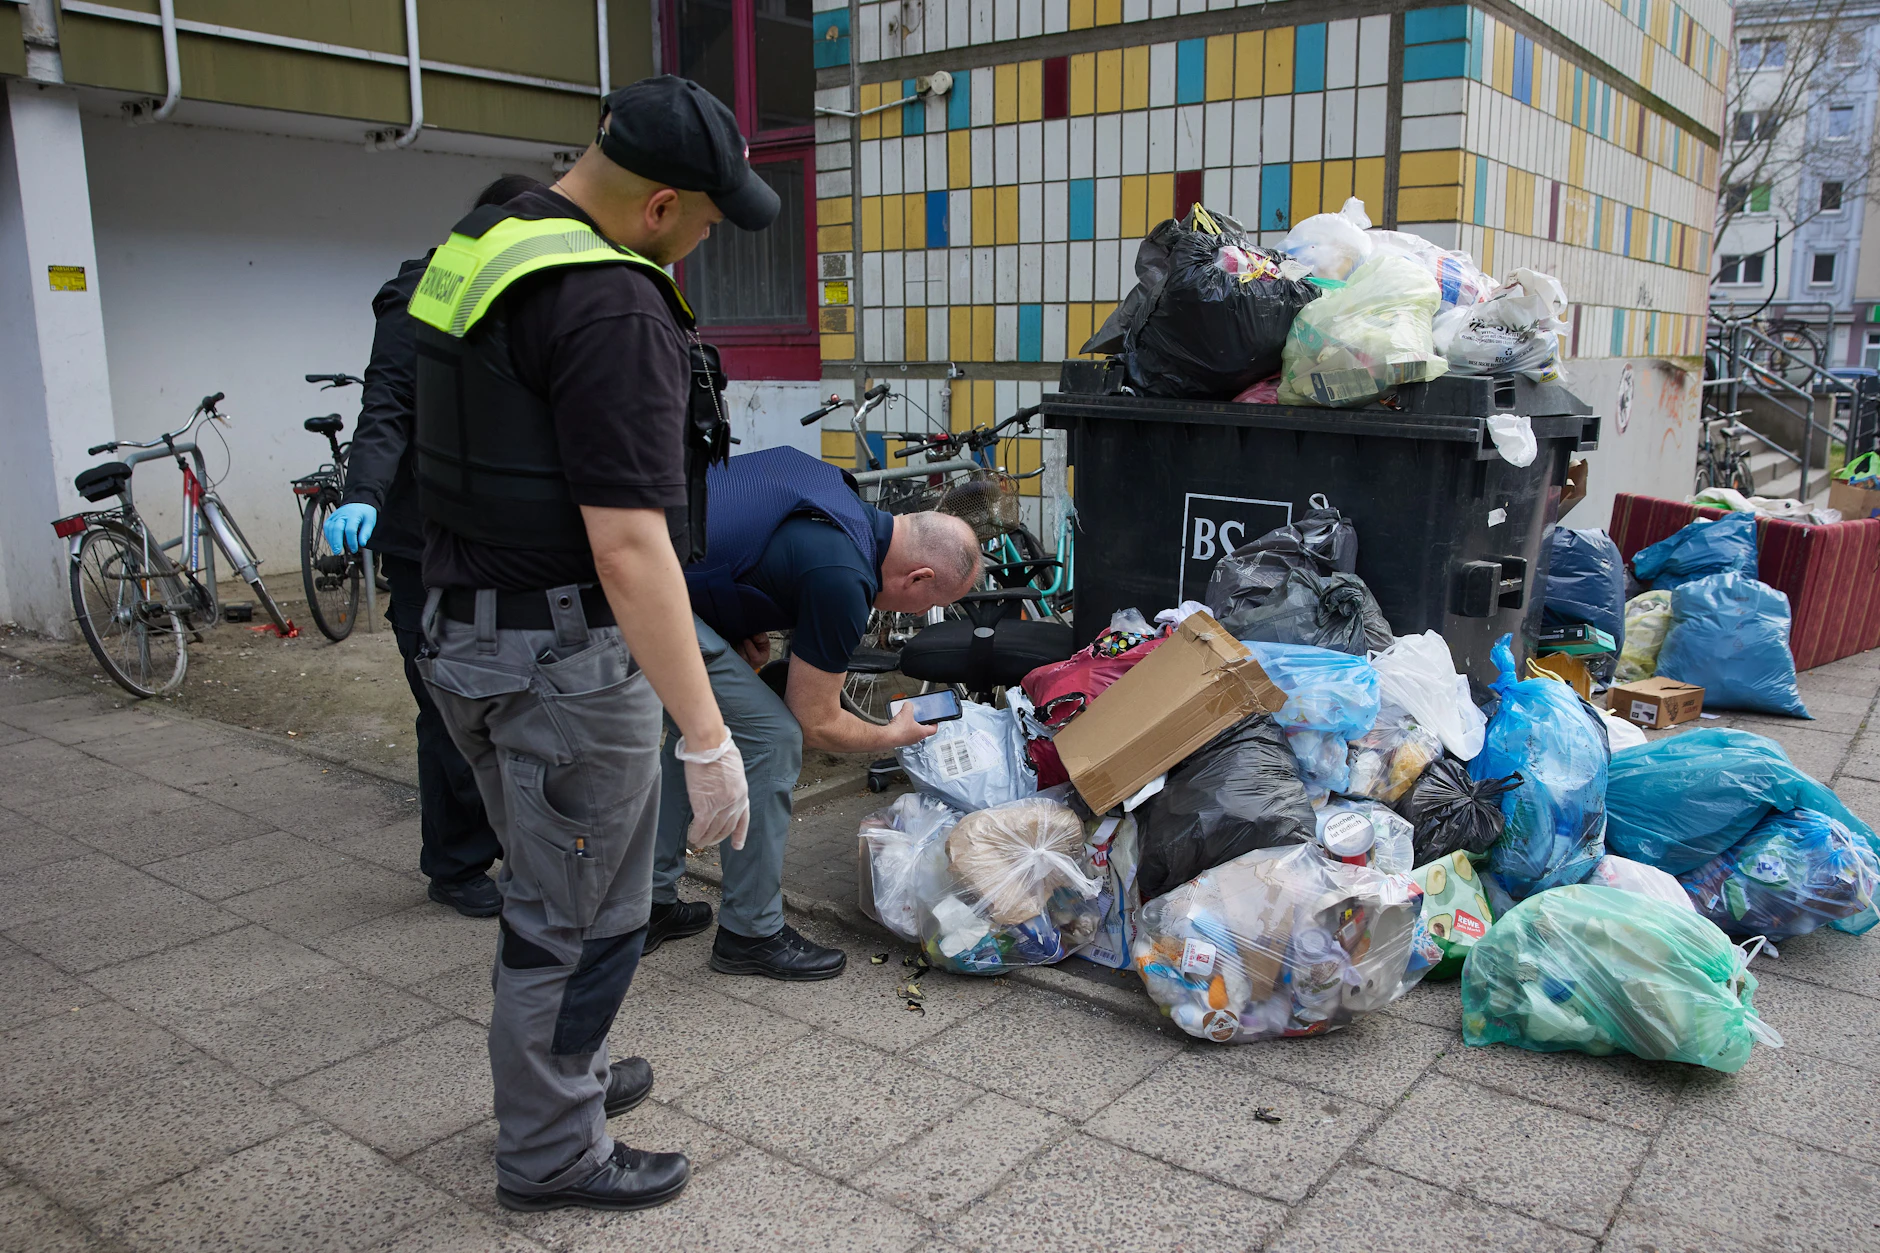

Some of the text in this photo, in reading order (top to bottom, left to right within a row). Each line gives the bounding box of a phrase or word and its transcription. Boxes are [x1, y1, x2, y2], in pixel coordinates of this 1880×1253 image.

[1192, 517, 1245, 560] BS
[1326, 814, 1356, 831] Rauchen
[1339, 820, 1362, 834] tödlich
[1458, 914, 1480, 929] REWE
